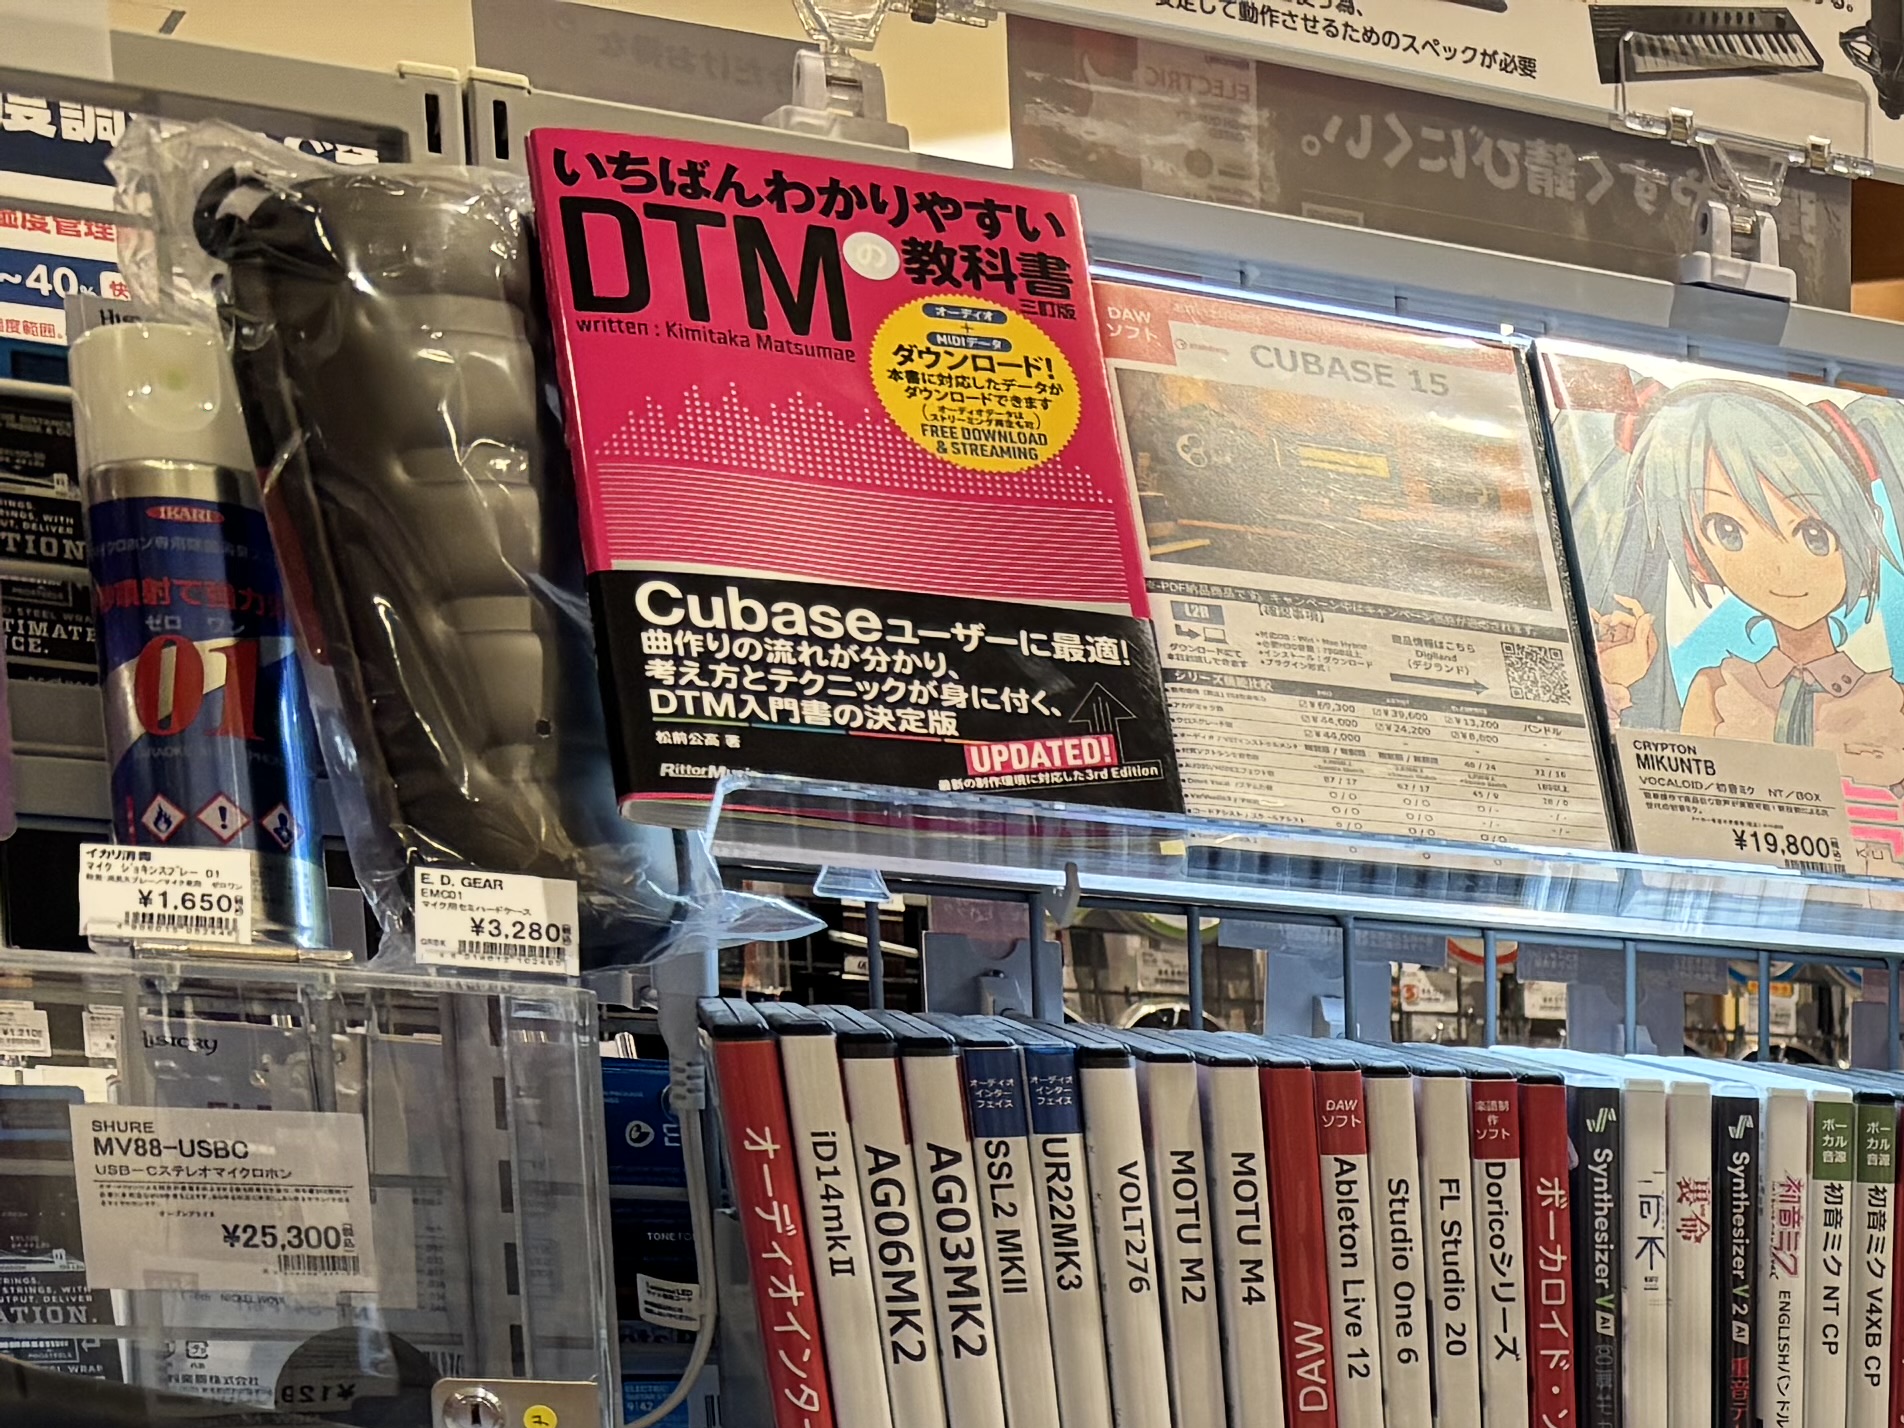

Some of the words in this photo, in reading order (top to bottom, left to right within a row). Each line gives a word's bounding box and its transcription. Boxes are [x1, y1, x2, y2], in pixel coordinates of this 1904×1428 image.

[553, 146, 1066, 242] いちばんわかりやすい
[577, 317, 650, 337] written
[666, 321, 751, 348] Kimitaka
[757, 334, 856, 364] Matsumae
[892, 346, 1054, 380] ダウンロード!
[887, 368, 1063, 398] 本書に対応したデータが
[1250, 344, 1393, 387] CUBASE
[1408, 369, 1448, 396] 15
[921, 424, 958, 441] FREE
[961, 427, 1047, 446] DOWNLOAD
[160, 506, 211, 522] IKARI
[635, 580, 1130, 667] Cubaseユーザーに最適!
[651, 690, 959, 736] DTM入門書の決定版
[971, 739, 1112, 773] UPDATED!
[1632, 740, 1698, 757] CRYPTON
[1636, 754, 1716, 775] MIKUNTB
[1733, 830, 1831, 859] ¥19,800
[470, 917, 561, 941] ¥3,280
[91, 1120, 155, 1134] SHURE
[93, 1138, 249, 1160] MV88-USBC
[984, 1139, 1018, 1218] SSL2
[1170, 1150, 1200, 1247] MOTU
[1231, 1153, 1261, 1245] MOTU
[1440, 1179, 1461, 1211] FL
[1041, 1138, 1082, 1292] UR22MK3
[1118, 1161, 1151, 1294] VOLT276
[1333, 1157, 1358, 1268] Ableton
[1388, 1179, 1413, 1271] Studio
[864, 1144, 926, 1364] AG06MK2
[927, 1141, 988, 1360] AG03MK2
[994, 1229, 1028, 1295] MKII
[1440, 1220, 1465, 1311] Studio
[1485, 1162, 1520, 1361] Doricoシリーズ
[1180, 1258, 1205, 1304] M2
[1239, 1258, 1266, 1306] M4
[1342, 1279, 1364, 1338] Live
[1394, 1282, 1414, 1338] One
[1398, 1349, 1418, 1364] 6
[1446, 1323, 1466, 1356] 20
[1292, 1322, 1328, 1412] DAW
[1348, 1350, 1369, 1379] 12
